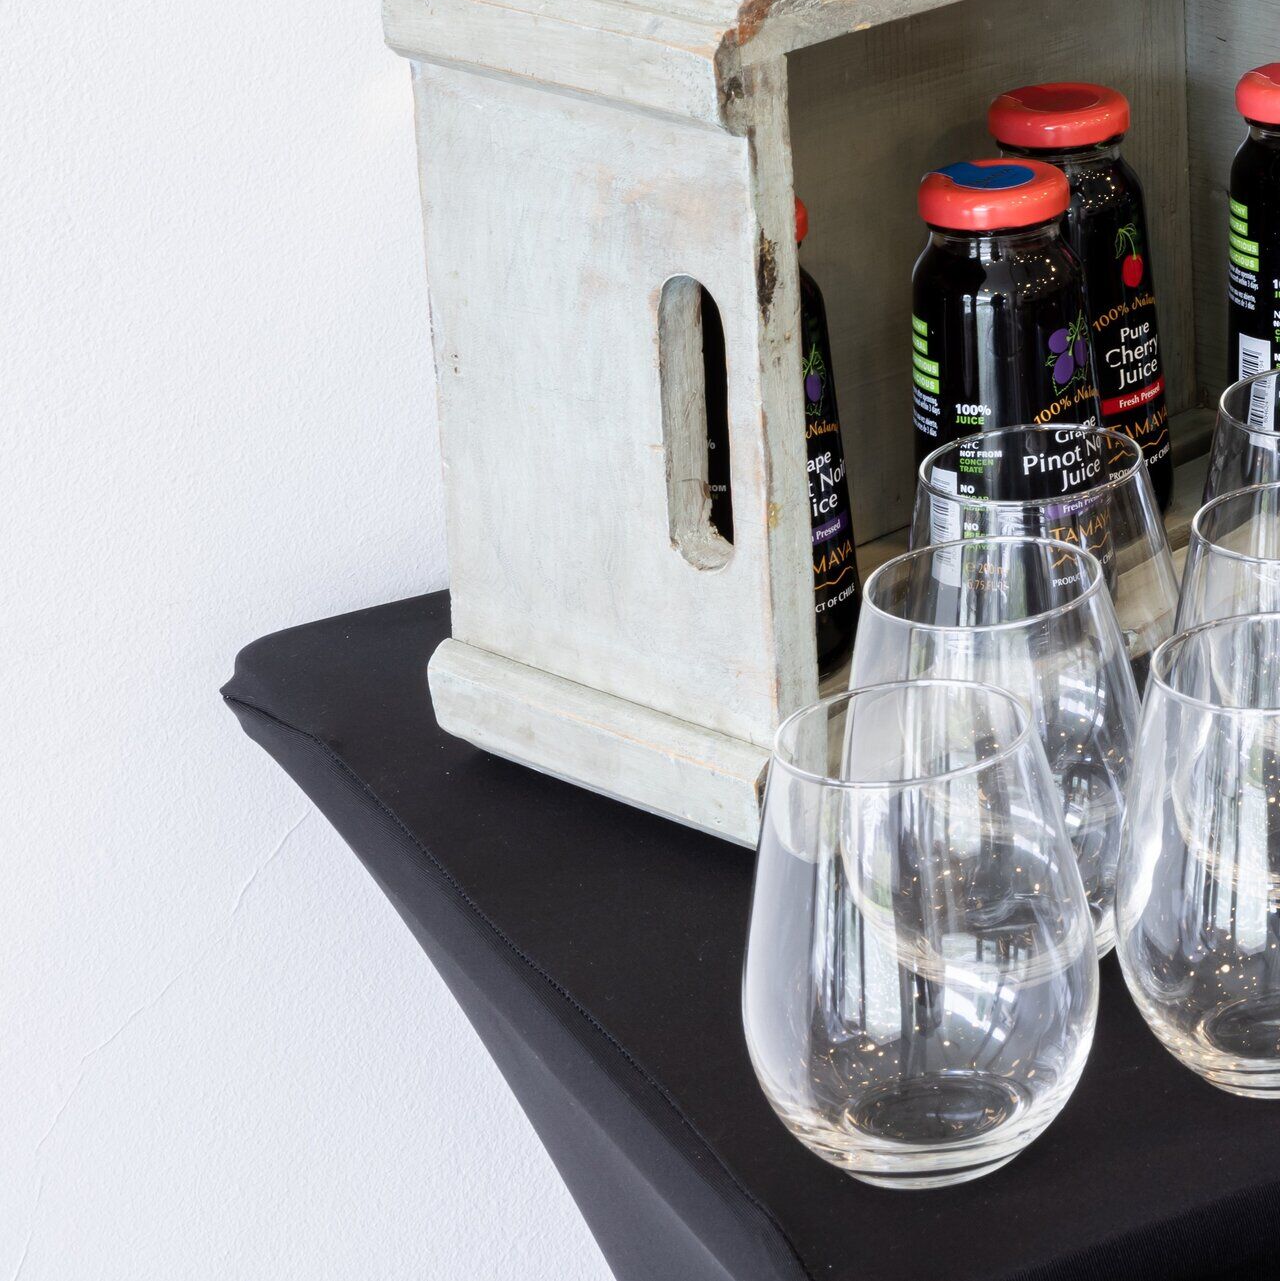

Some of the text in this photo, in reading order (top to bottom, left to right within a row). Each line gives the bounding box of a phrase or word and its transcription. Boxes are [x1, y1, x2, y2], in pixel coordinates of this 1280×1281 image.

[1093, 302, 1129, 332] 100%
[1120, 321, 1149, 342] Pure
[1105, 334, 1158, 368] Cherry
[1118, 358, 1158, 390] Juice
[1119, 382, 1160, 409] Fresh Pressed
[956, 403, 991, 416] 100%
[956, 416, 985, 425] JUICE
[1034, 395, 1071, 424] 100%
[960, 458, 994, 466] CONCEN
[960, 465, 983, 474] TRATE
[1023, 446, 1082, 475] Pinot
[1061, 459, 1100, 492] Juice
[960, 485, 975, 494] NO
[816, 520, 840, 540] Pressed
[813, 542, 853, 574] MAYA
[827, 583, 855, 608] OF CHILE
